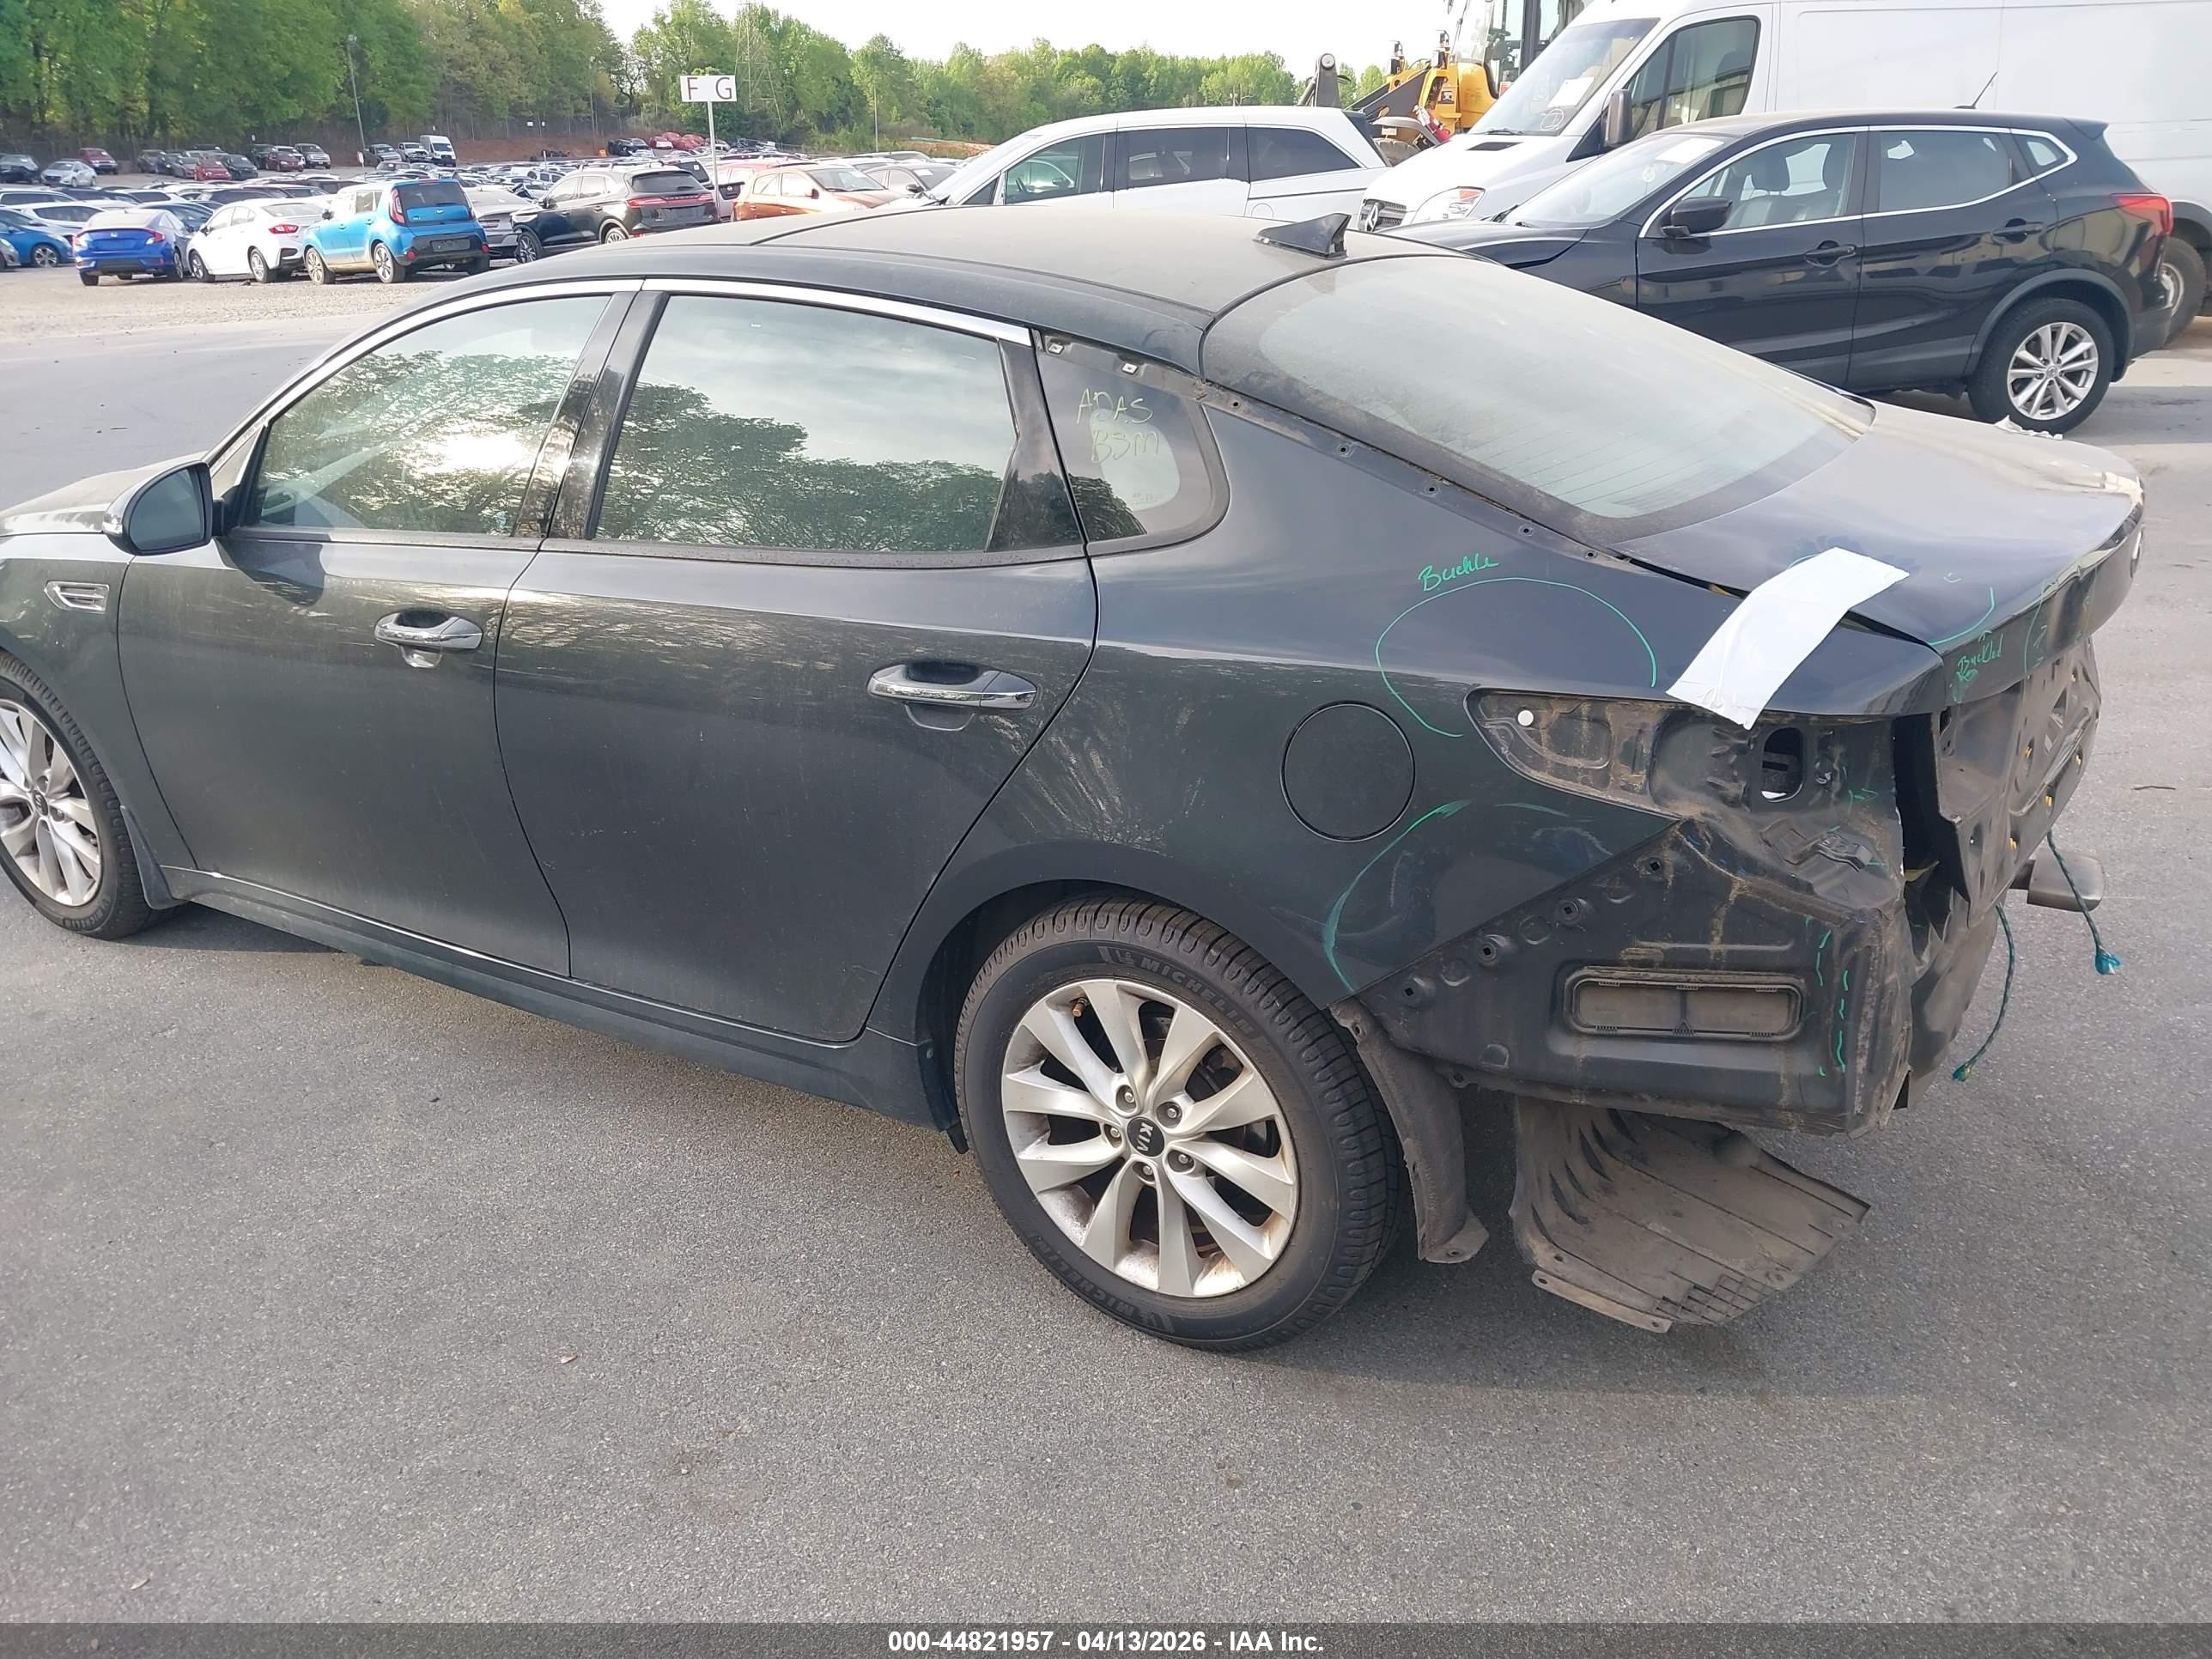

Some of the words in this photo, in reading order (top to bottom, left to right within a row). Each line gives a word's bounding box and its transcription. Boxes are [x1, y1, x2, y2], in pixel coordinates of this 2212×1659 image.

[686, 76, 698, 100] F
[715, 76, 732, 100] G
[1076, 388, 1154, 425] ADAS
[1140, 957, 1256, 1036] MICHELIN
[1136, 1121, 1154, 1152] KIA
[1032, 1236, 1135, 1317] MICHELIN
